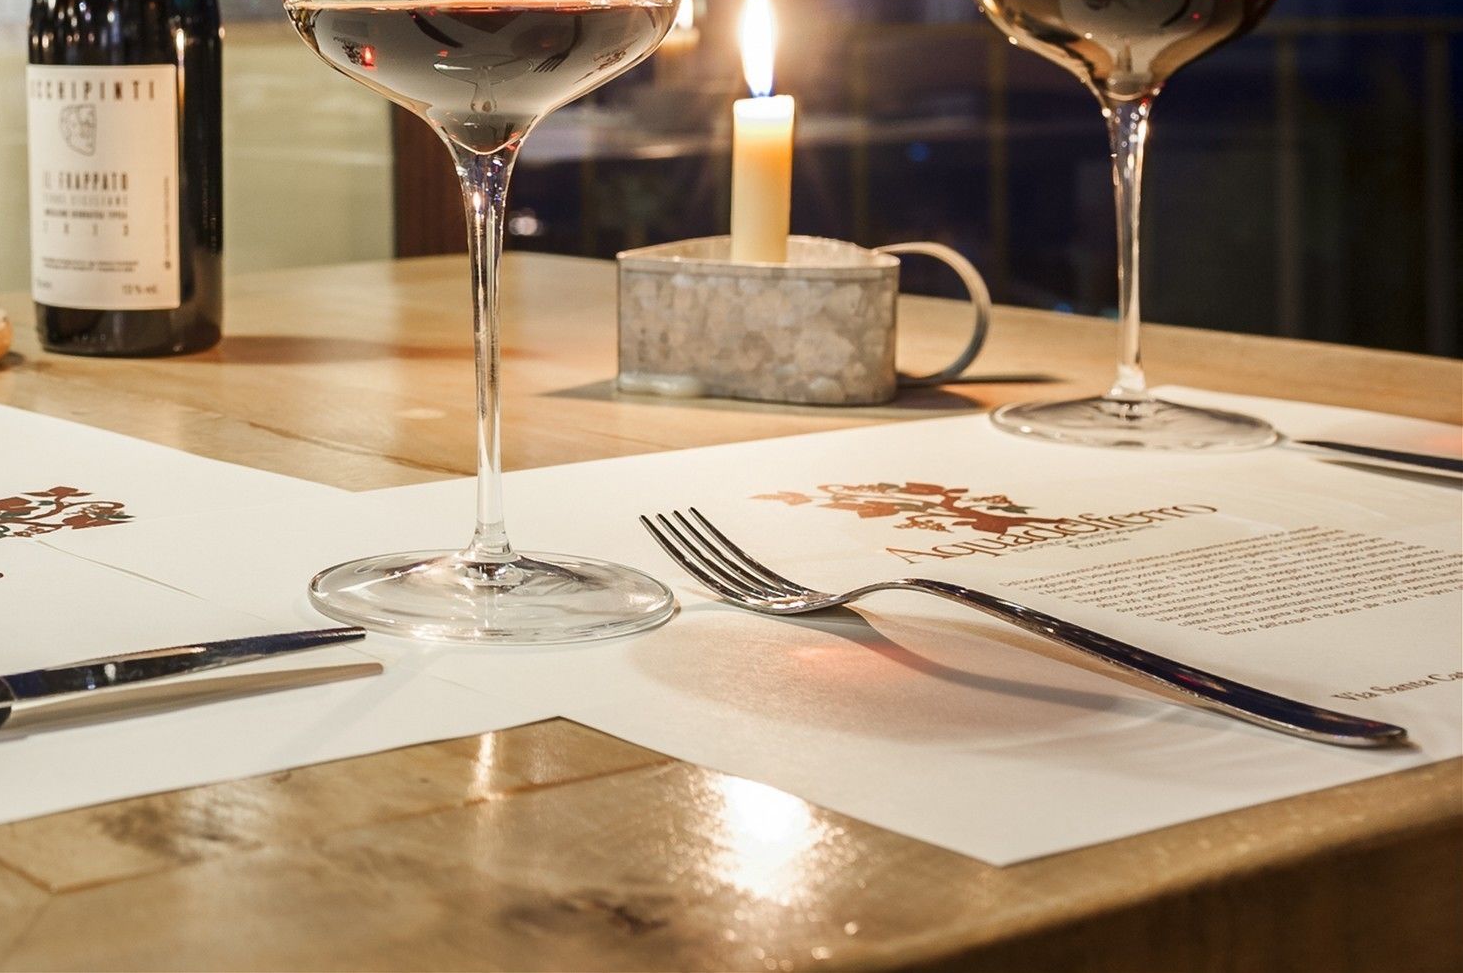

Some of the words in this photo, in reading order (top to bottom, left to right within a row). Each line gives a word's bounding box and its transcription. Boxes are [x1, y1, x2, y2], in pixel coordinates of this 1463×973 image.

[885, 503, 1218, 565] Aquadelferro
[1330, 690, 1381, 702] Via
[1369, 679, 1438, 694] Santa
